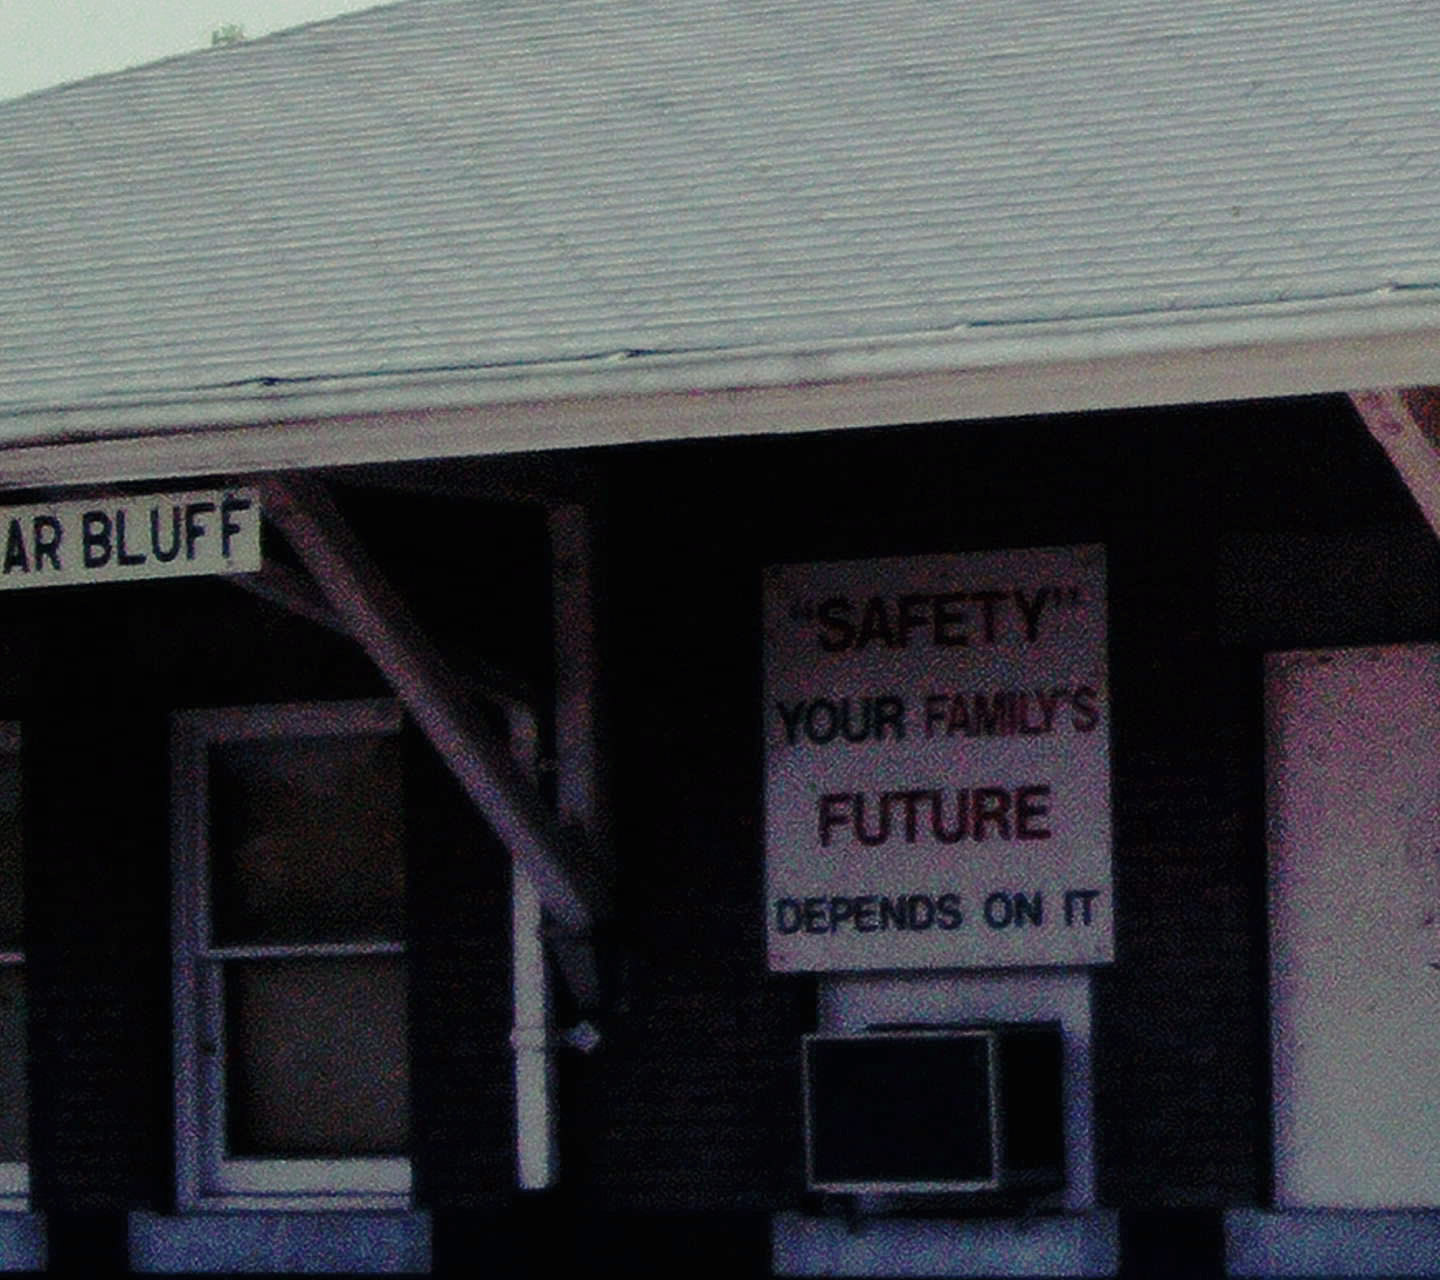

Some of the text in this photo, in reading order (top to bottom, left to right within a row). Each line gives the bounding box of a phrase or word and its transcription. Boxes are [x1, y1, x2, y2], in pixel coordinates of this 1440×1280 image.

[82, 494, 251, 569] BLUFF
[777, 686, 1099, 744] YOUR FAMILY'S
[818, 785, 1052, 848] FUTURE
[775, 889, 1101, 934] DEPENDS ON IT
